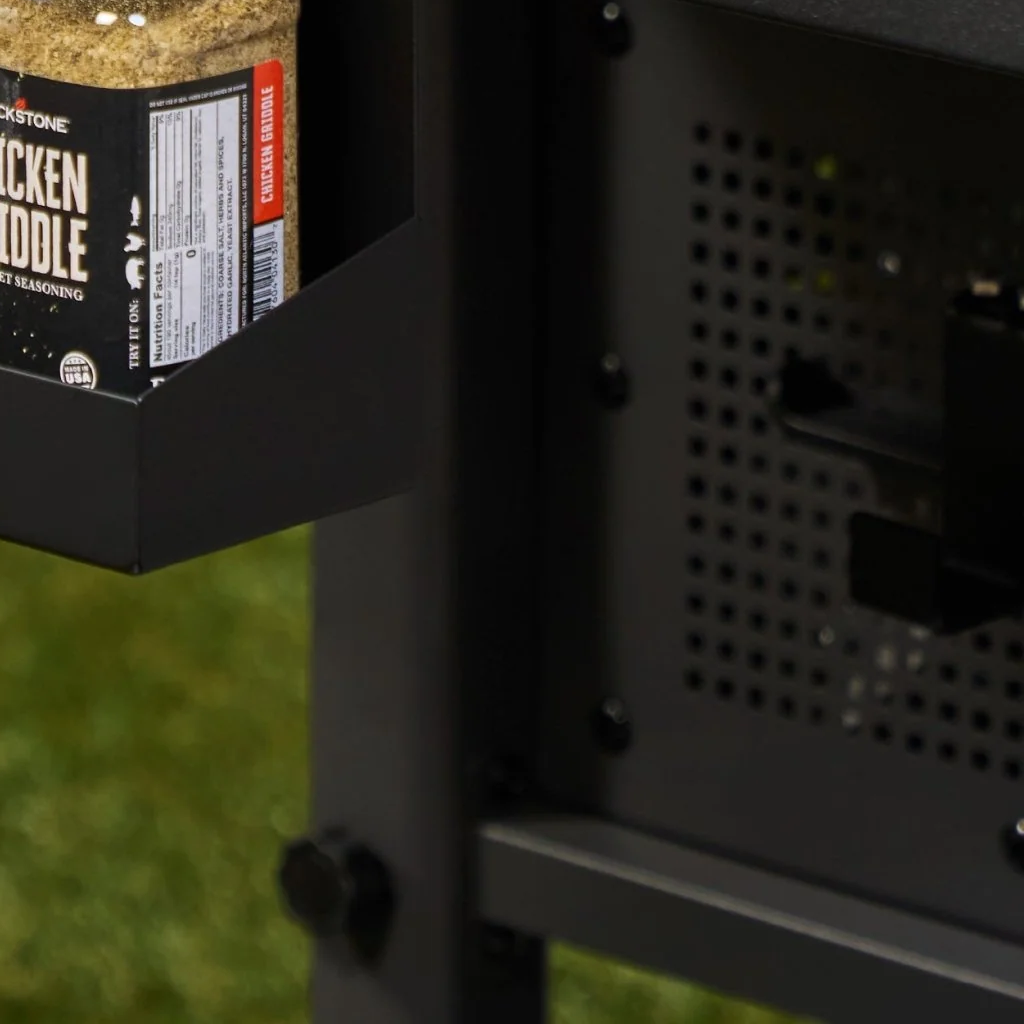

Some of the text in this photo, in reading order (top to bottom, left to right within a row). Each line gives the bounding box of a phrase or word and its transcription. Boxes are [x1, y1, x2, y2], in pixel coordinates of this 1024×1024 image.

[261, 85, 273, 204] CHICKEN GRIDDLE
[186, 250, 196, 258] 0
[14, 276, 84, 301] SEASONING
[153, 262, 163, 362] Nutrition Facts
[129, 300, 139, 370] TRY IT ON:
[65, 372, 92, 384] USA
